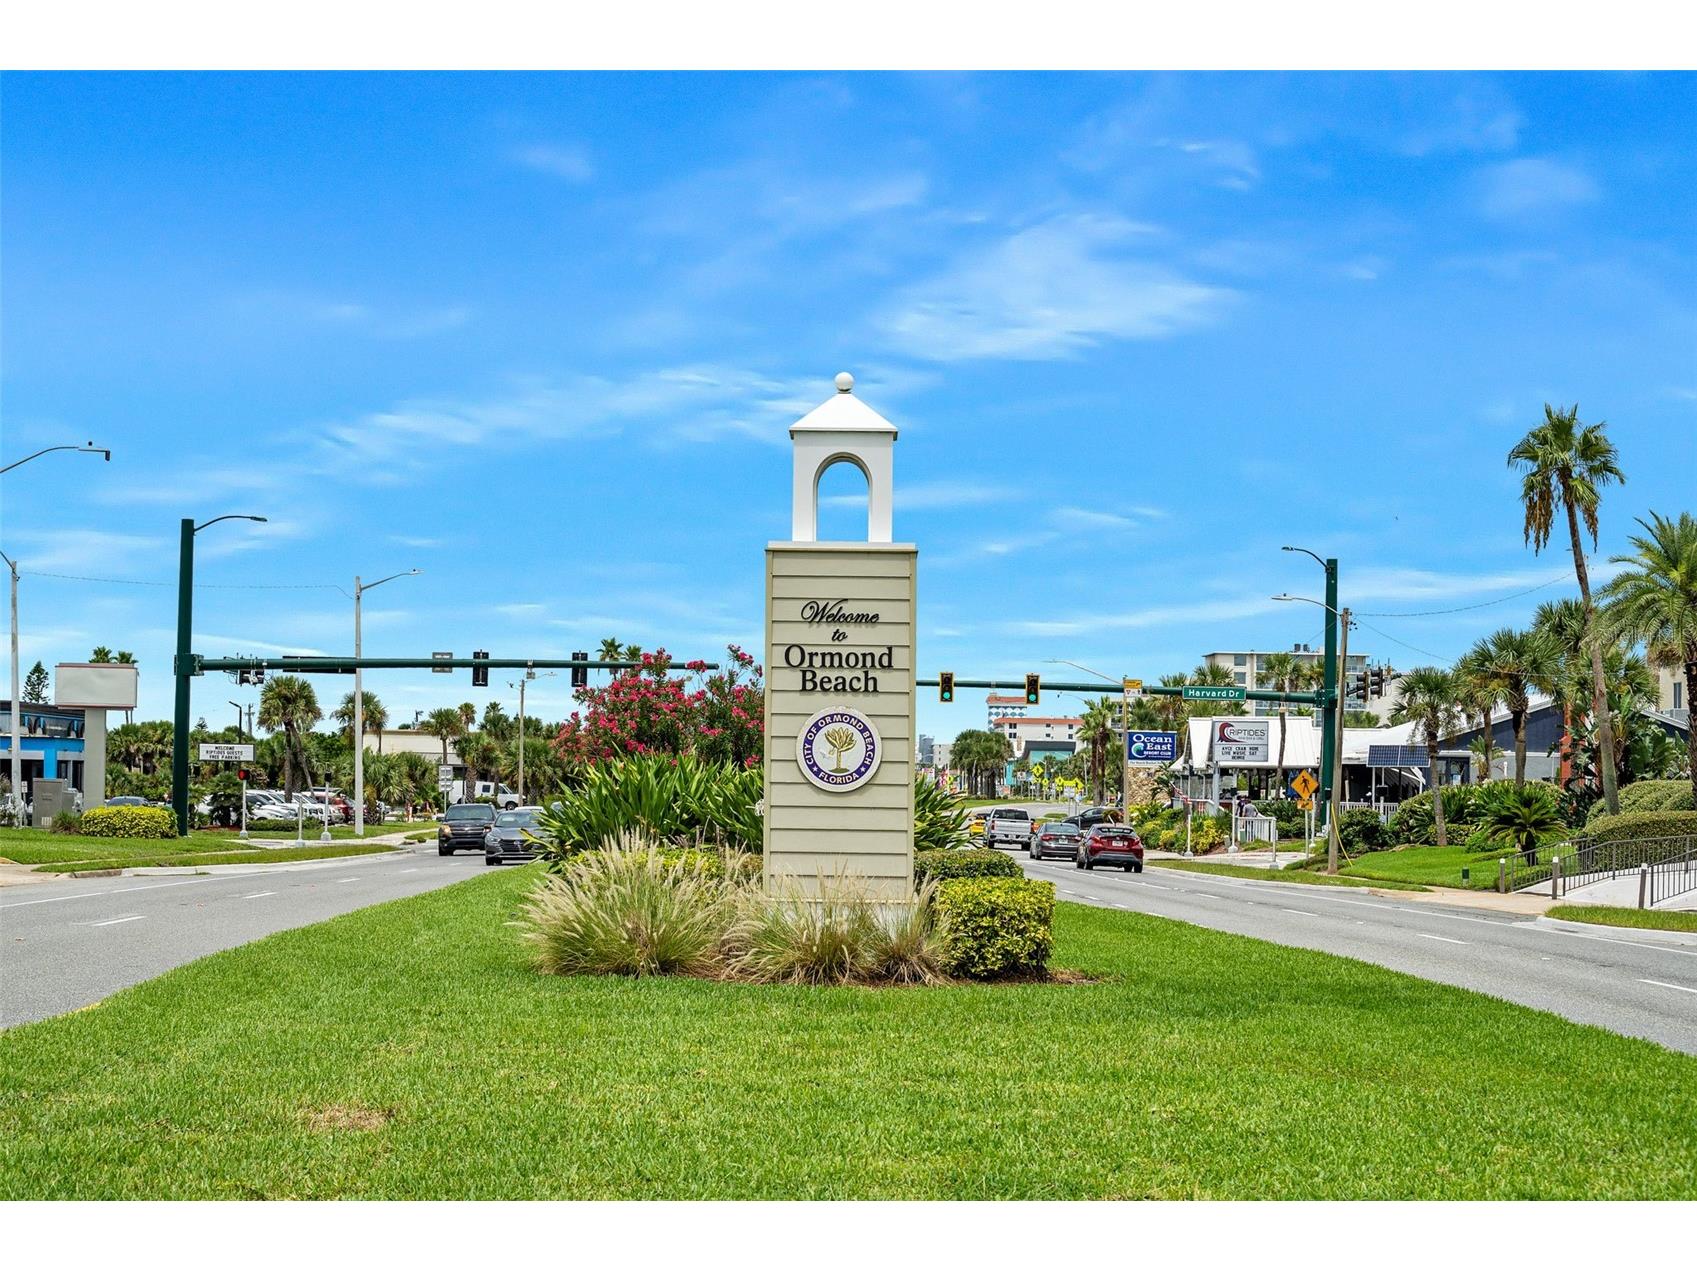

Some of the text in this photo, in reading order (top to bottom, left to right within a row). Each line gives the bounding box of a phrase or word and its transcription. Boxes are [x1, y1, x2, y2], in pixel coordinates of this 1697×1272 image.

[801, 599, 880, 624] Welcome
[831, 628, 848, 642] to
[784, 644, 894, 668] Ormond
[800, 669, 879, 693] Beach
[1188, 689, 1240, 698] Harvard Dr
[804, 714, 874, 765] CITY OF ORMOND BEACH
[1132, 733, 1173, 743] Ocean
[1229, 729, 1266, 737] RIPTIDES
[1146, 742, 1173, 751] East
[818, 772, 859, 784] FLORIDA
